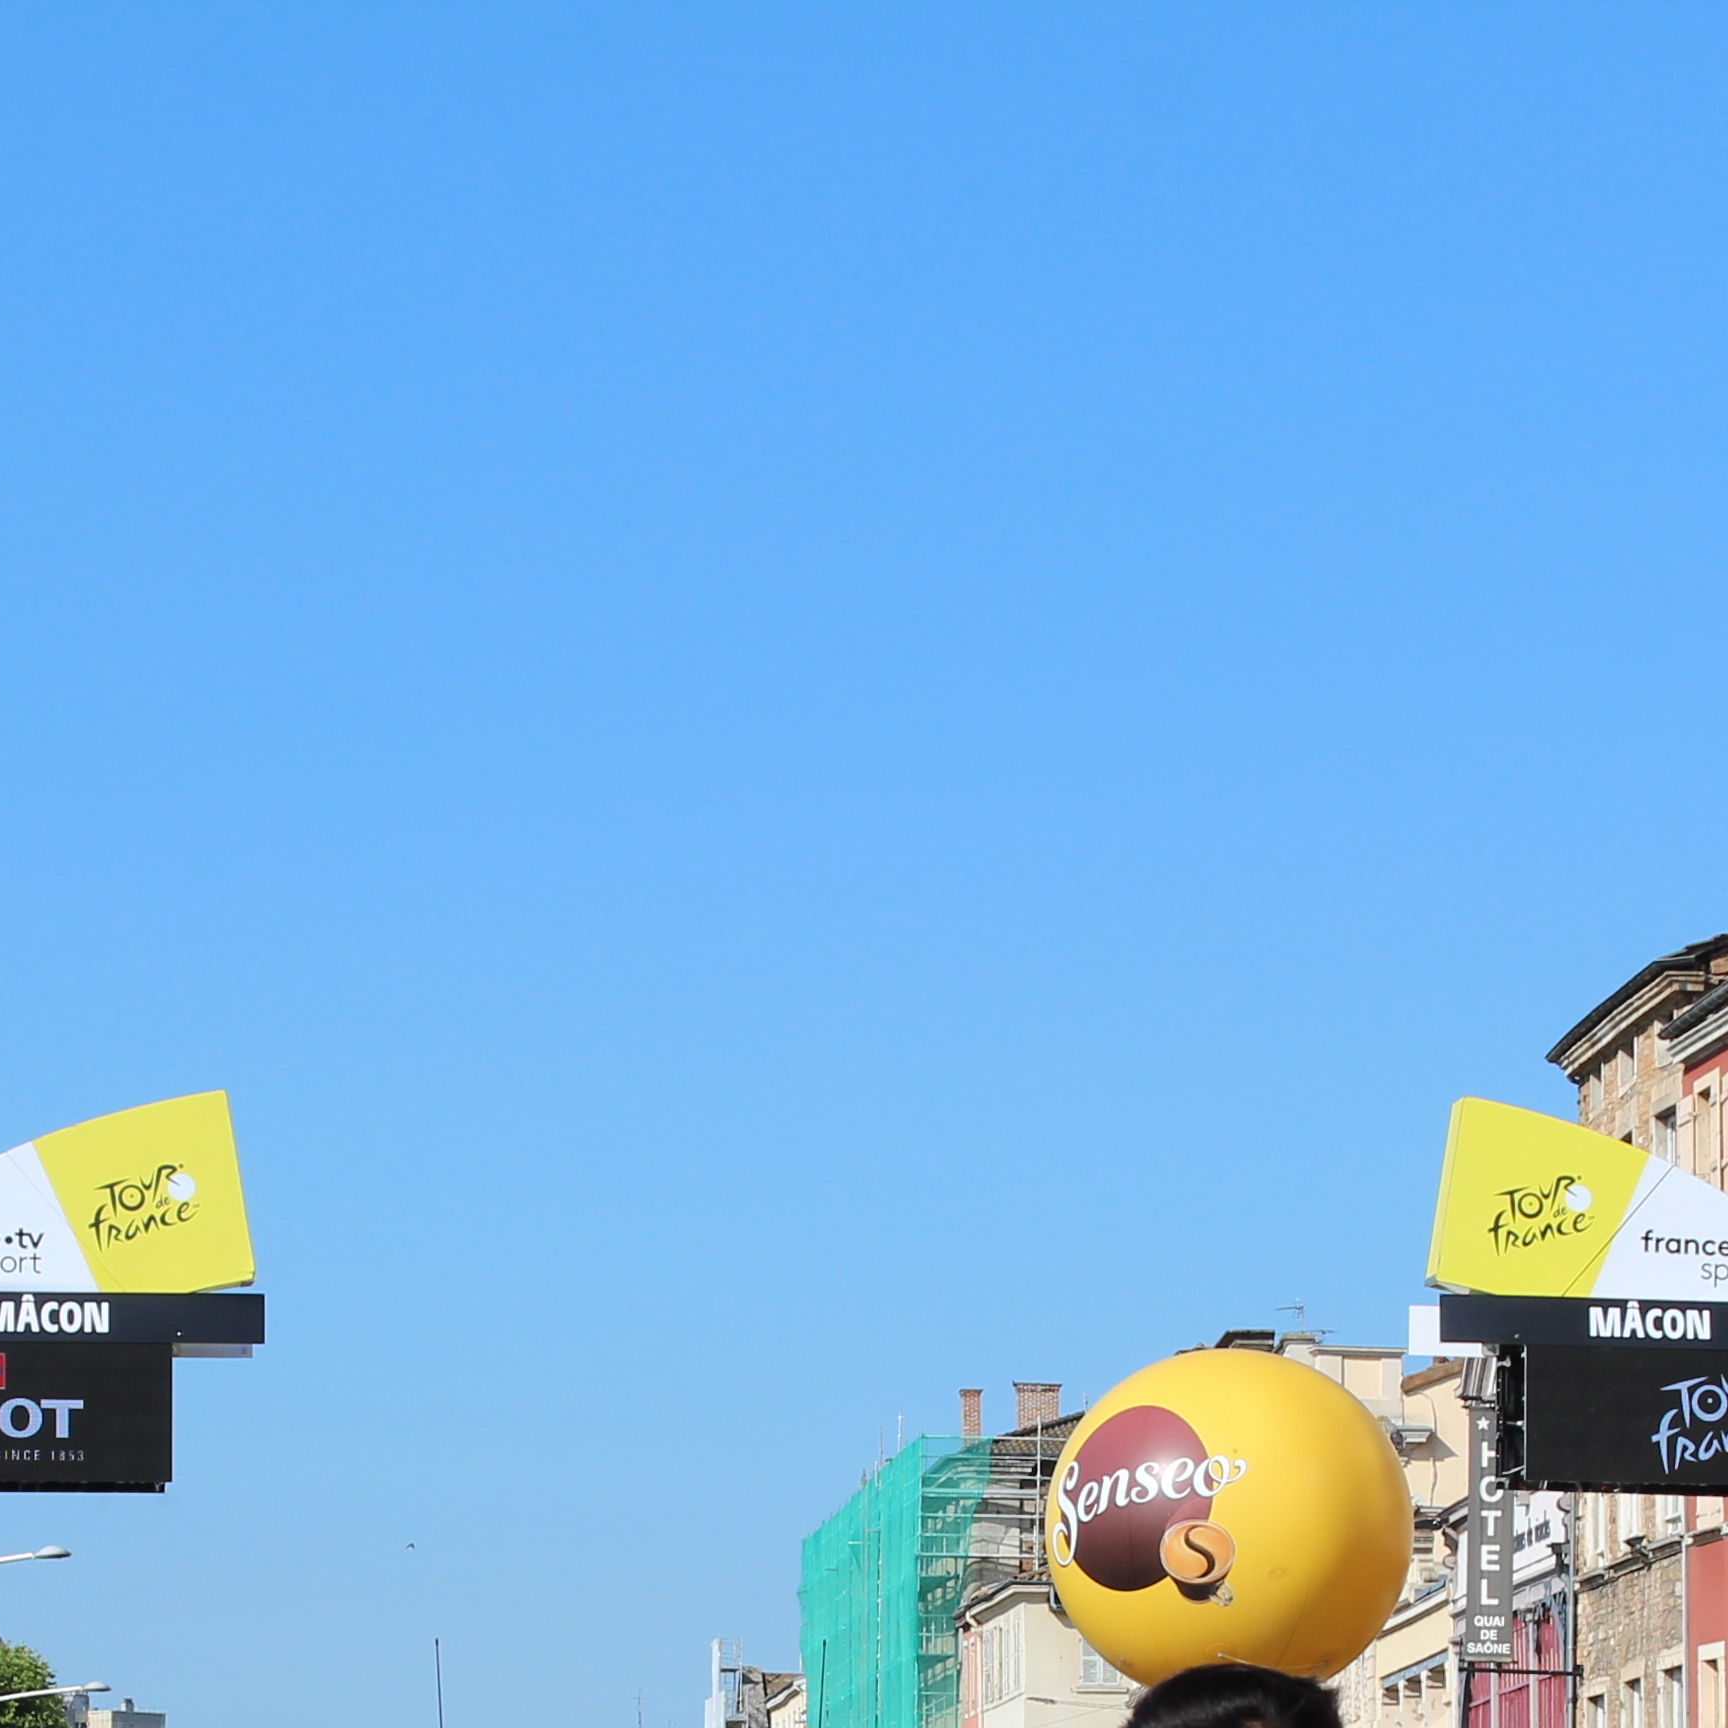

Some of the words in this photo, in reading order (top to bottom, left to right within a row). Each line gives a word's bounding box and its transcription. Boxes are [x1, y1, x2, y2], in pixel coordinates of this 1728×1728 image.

[87, 1201, 198, 1254] france
[1486, 1209, 1592, 1259] france
[1587, 1302, 1712, 1340] MÂCON
[50, 1449, 85, 1463] 1853
[1052, 1453, 1248, 1567] Senseo
[1473, 1614, 1505, 1628] QUAI
[1466, 1640, 1511, 1655] SAÔNE
[1480, 1628, 1498, 1641] DE
